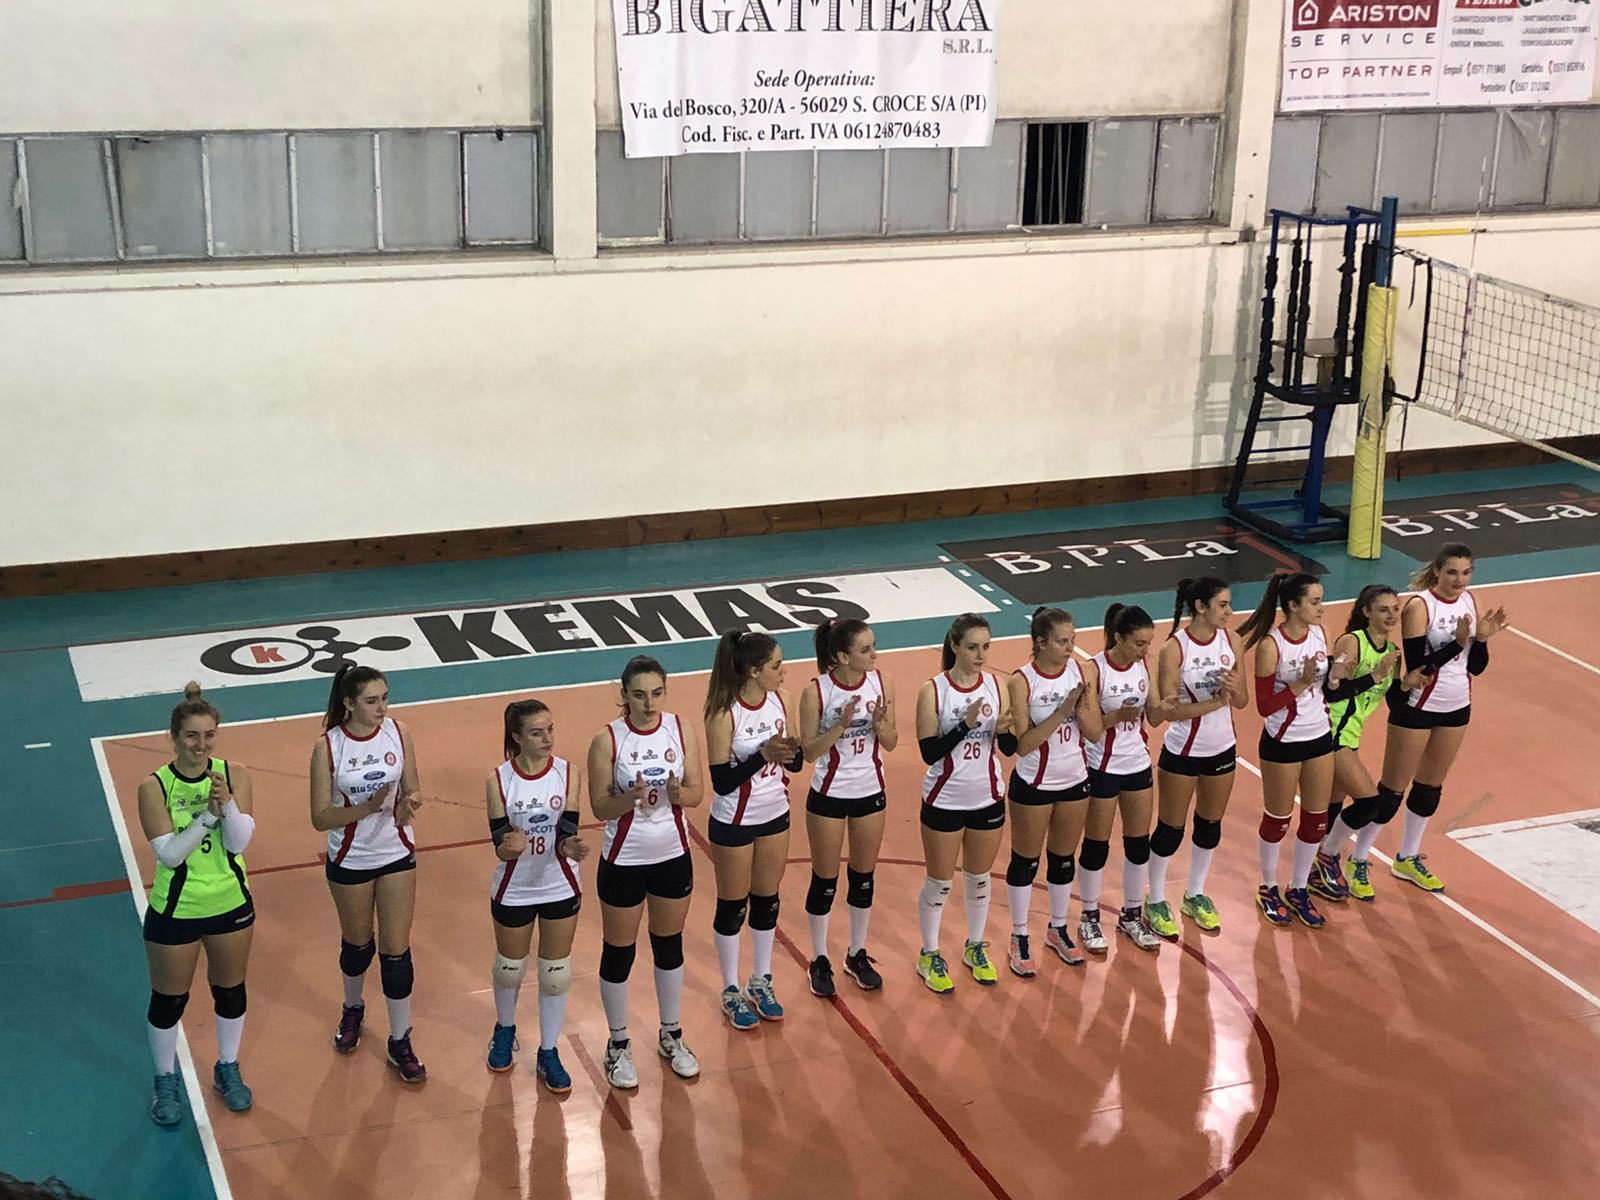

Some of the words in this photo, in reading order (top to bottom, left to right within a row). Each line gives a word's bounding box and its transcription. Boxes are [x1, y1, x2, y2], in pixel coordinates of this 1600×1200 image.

[622, 0, 993, 36] BIGATTIERA
[1329, 5, 1431, 22] ARISTON
[942, 38, 993, 54] S.R.L.
[1291, 32, 1435, 47] SERVICE
[753, 69, 790, 87] Sede
[794, 69, 875, 92] Operativa:
[1288, 66, 1330, 80] TOP
[1342, 64, 1432, 78] PARTNER
[630, 102, 658, 119] Via
[662, 99, 683, 118] del
[685, 98, 737, 117] Bosco,
[740, 97, 786, 115] 320/A
[800, 95, 848, 114] 56029
[852, 95, 867, 113] S.
[873, 94, 927, 113] CROCE
[931, 94, 956, 112] S/A
[959, 93, 987, 113] (PI)
[682, 125, 717, 143] Cod.
[722, 125, 752, 142] Fisc.
[757, 130, 765, 140] e
[770, 123, 805, 140] Part.
[811, 121, 838, 139] IVA
[844, 120, 941, 139] 06124870483
[413, 581, 870, 663] KEMAS
[1057, 725, 1072, 744] 10
[851, 738, 866, 756] 15
[963, 741, 981, 760] 26
[648, 788, 658, 806] 6
[201, 833, 212, 854] 5
[529, 835, 546, 855] 18
